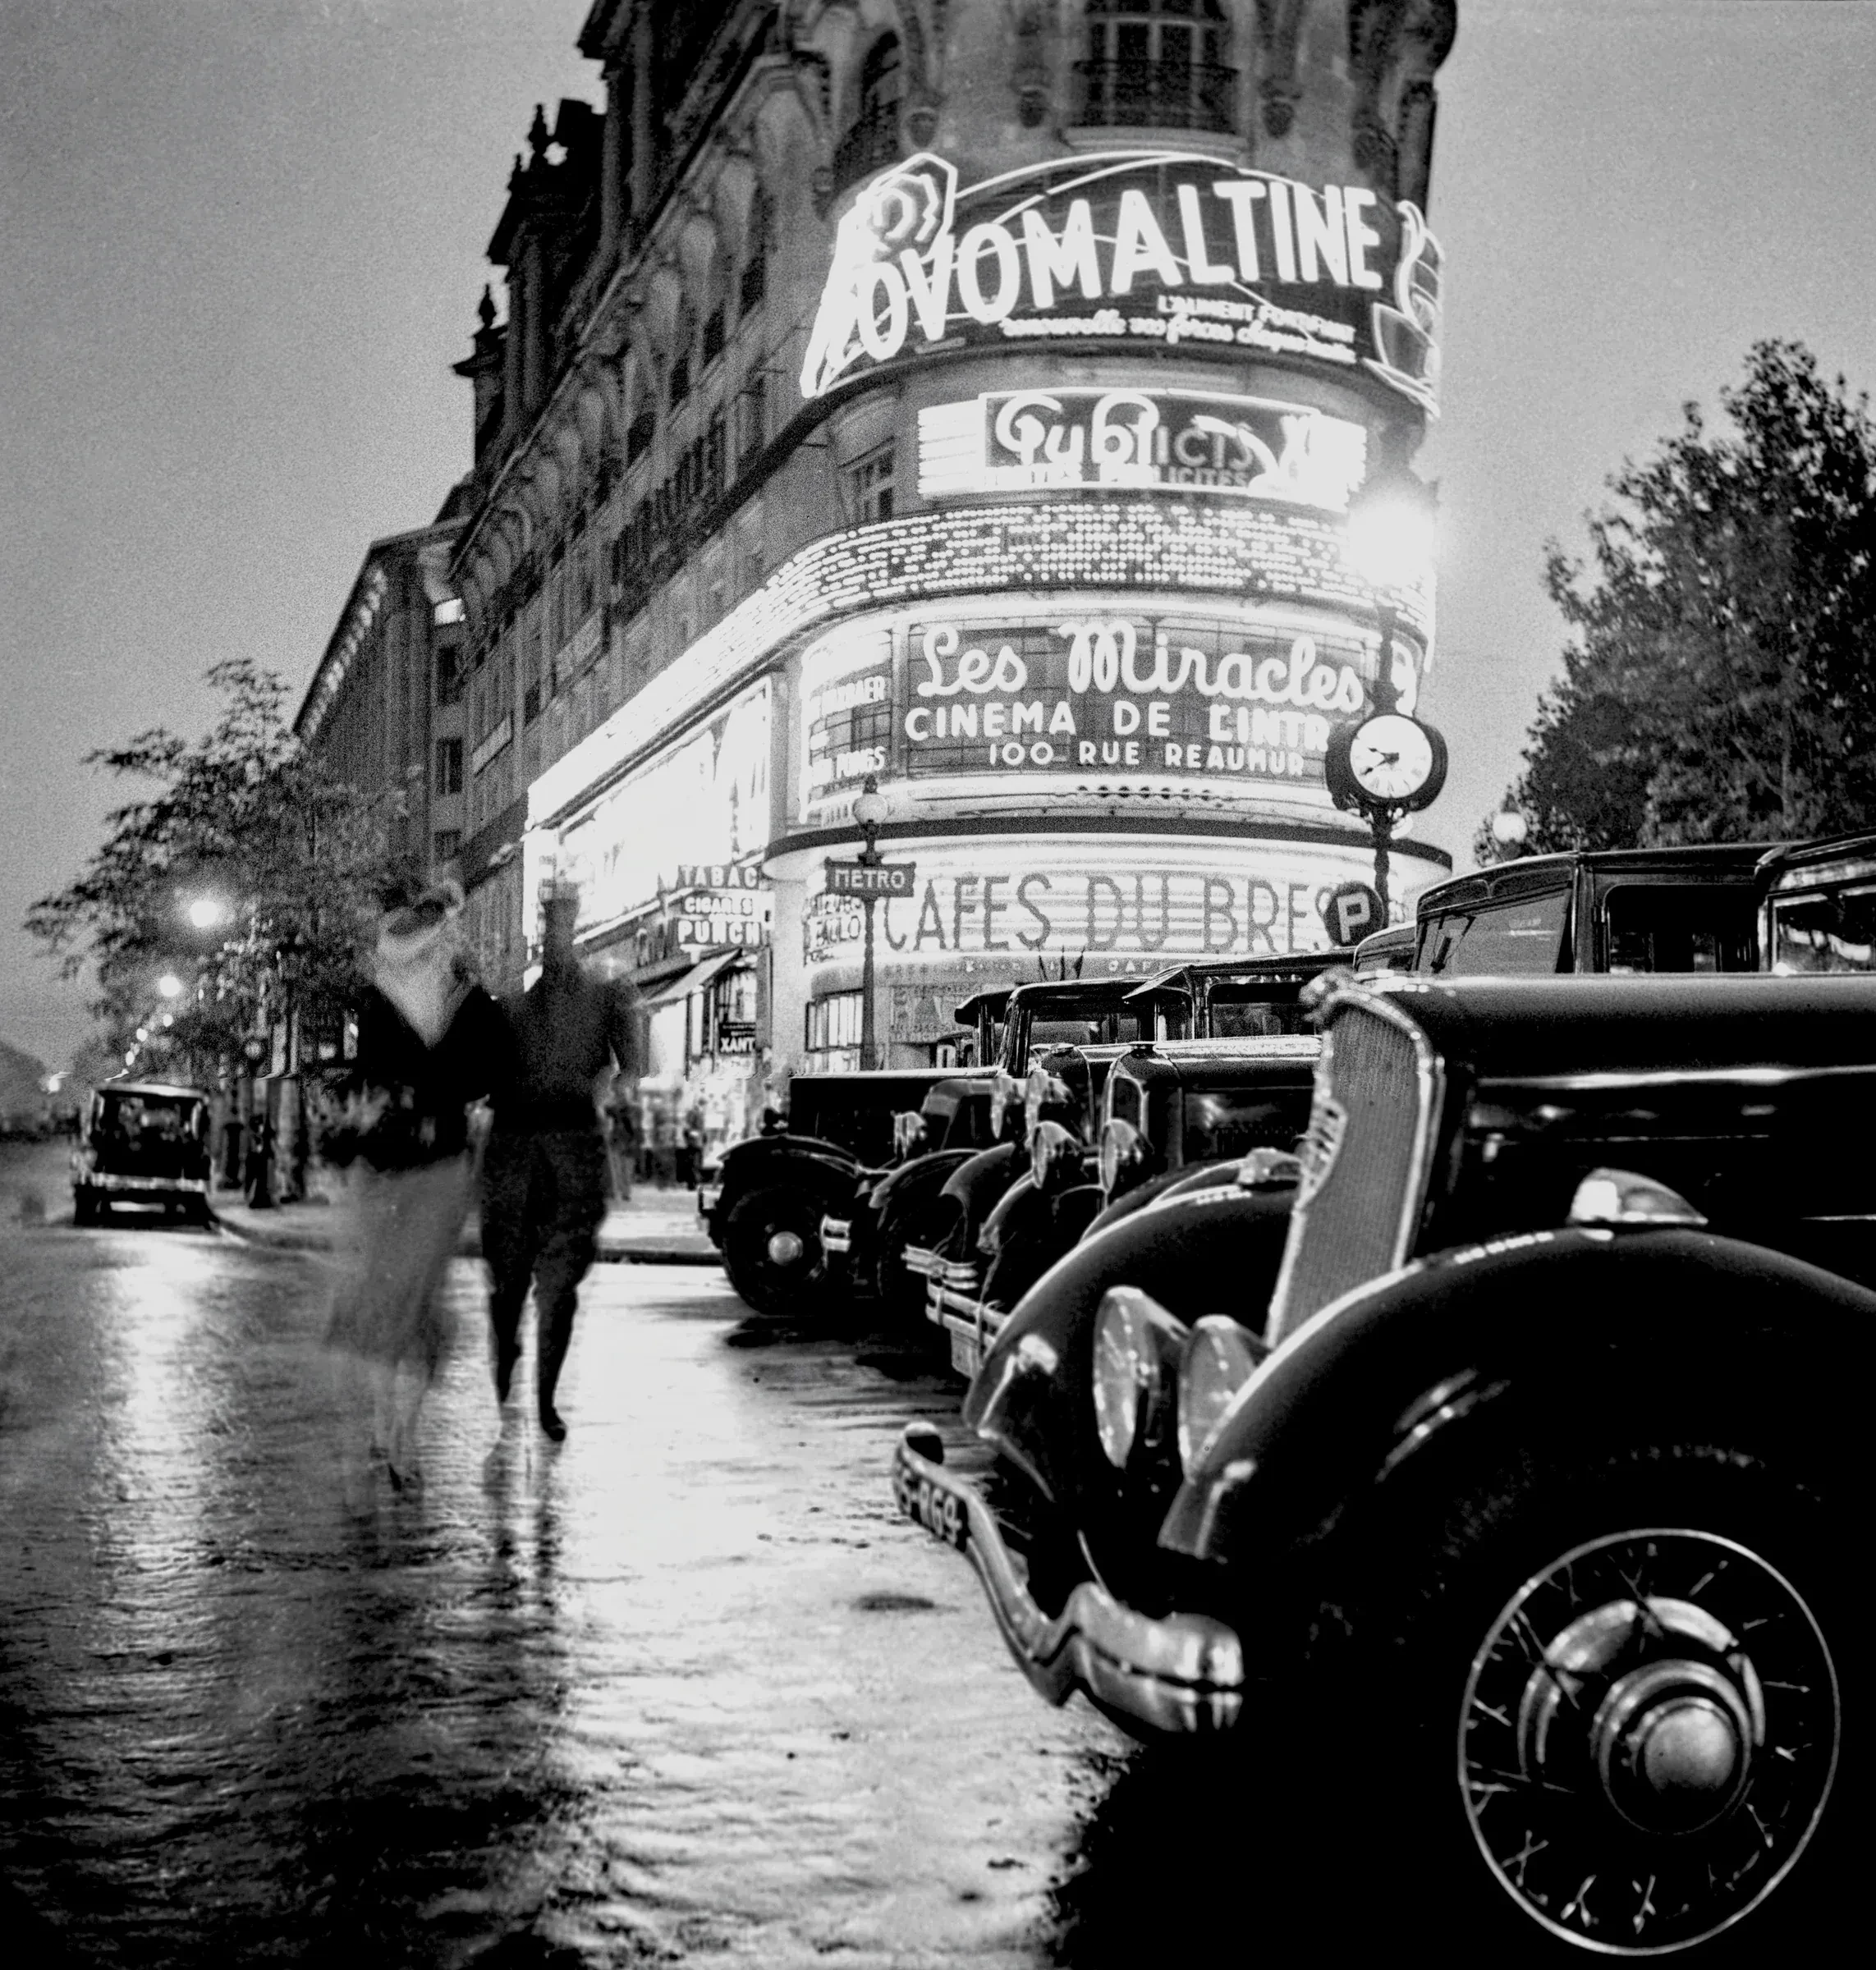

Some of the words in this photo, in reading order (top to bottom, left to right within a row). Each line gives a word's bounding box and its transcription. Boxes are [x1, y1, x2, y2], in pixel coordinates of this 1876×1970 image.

[851, 181, 1383, 361] OVOMALTINE
[917, 624, 1027, 698] Les
[1053, 620, 1365, 713] Miracles
[905, 701, 1077, 740] CINEMA
[1112, 700, 1171, 737] DE
[989, 741, 1054, 765] 100
[1079, 741, 1140, 765] RUE
[1165, 743, 1305, 776] REAUMUR
[680, 866, 758, 887] TABAC
[678, 920, 760, 945] PUNCH
[883, 873, 1053, 952] CAFES
[1088, 875, 1170, 950] DU
[1337, 891, 1371, 943] P
[720, 1037, 756, 1053] XANT
